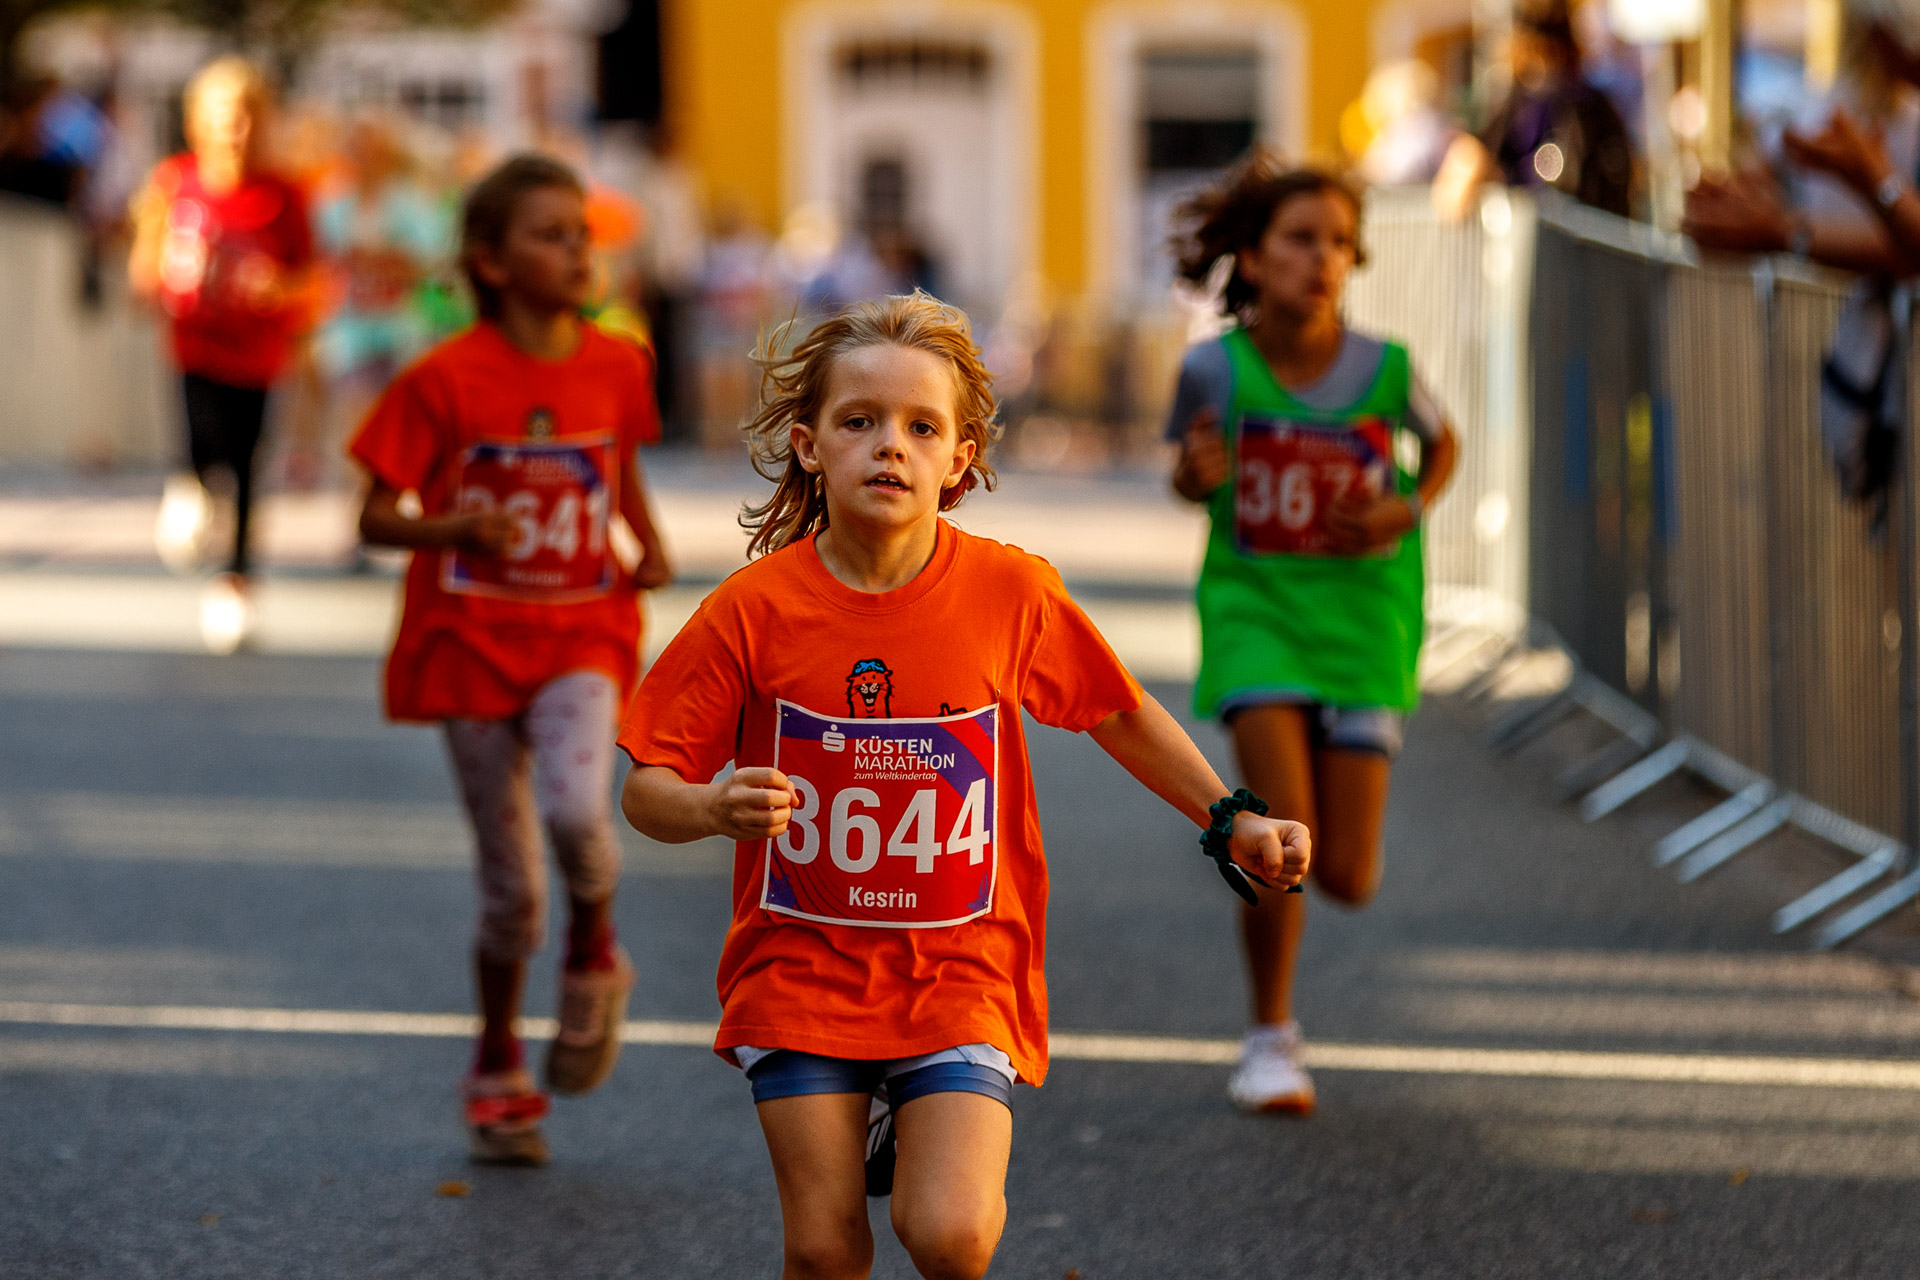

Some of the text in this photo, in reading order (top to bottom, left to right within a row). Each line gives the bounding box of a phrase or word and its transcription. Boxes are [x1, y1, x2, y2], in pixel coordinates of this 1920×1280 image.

[855, 735, 933, 754] KÜSTEN
[854, 753, 955, 770] MARATHON
[854, 772, 937, 781] zum Weltkindertag
[776, 775, 990, 873] 3644
[849, 887, 917, 908] Kesrin
